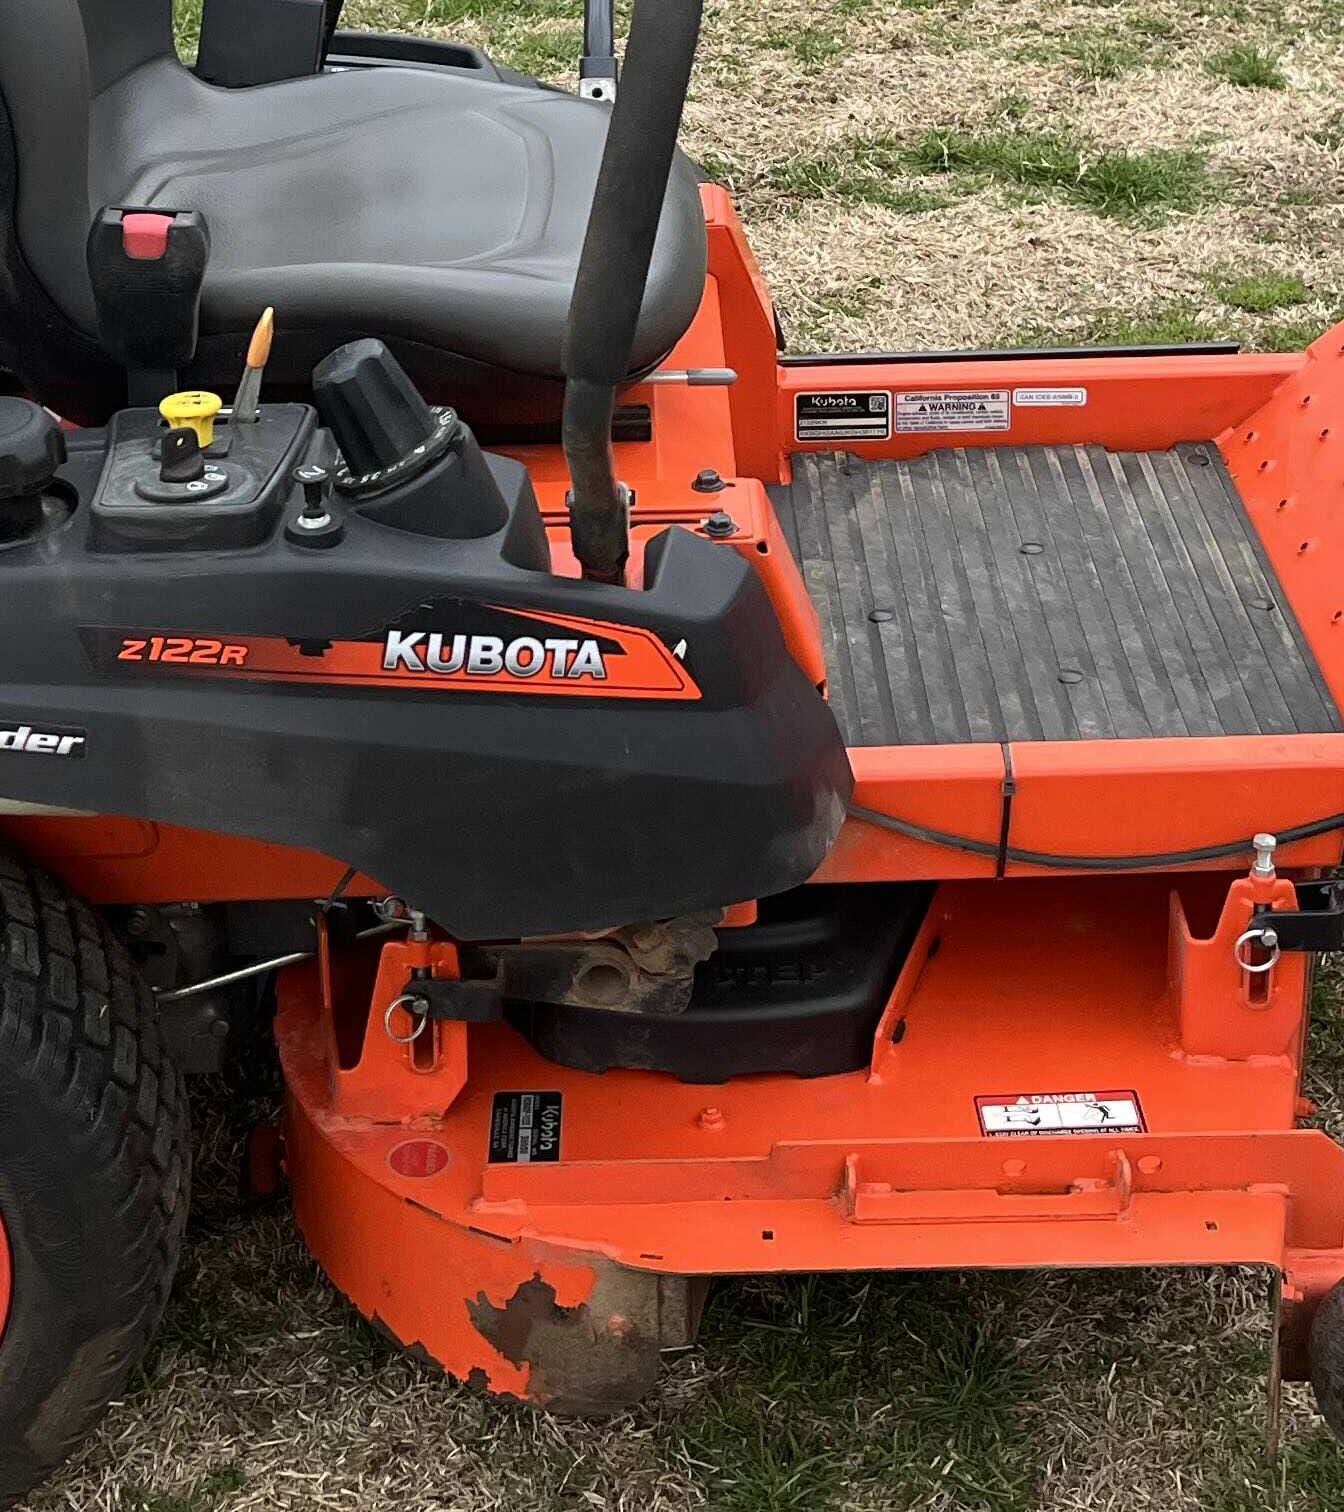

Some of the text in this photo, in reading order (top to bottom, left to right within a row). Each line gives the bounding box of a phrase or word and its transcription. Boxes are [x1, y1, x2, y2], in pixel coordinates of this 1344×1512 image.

[811, 396, 857, 406] Kubota
[905, 393, 942, 402] California
[944, 392, 989, 402] Proposition
[928, 402, 977, 412] WARNING
[117, 637, 249, 665] Z122R
[382, 630, 606, 679] KUBOTA
[1031, 1093, 1097, 1104] DANGER
[539, 1105, 560, 1150] Kubota
